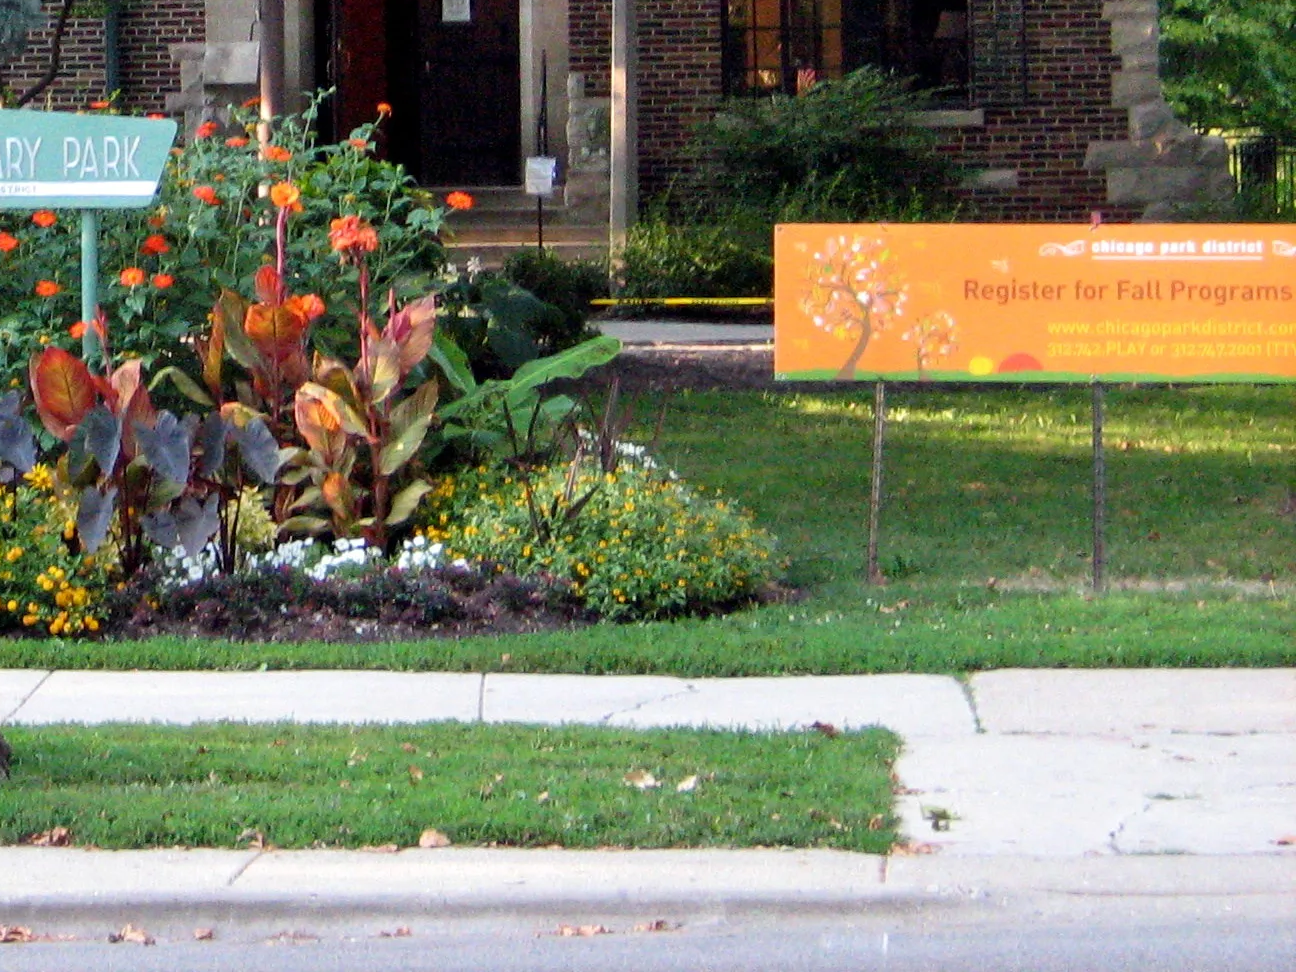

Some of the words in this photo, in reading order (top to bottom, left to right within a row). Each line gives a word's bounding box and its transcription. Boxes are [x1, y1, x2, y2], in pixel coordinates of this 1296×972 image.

[63, 135, 141, 179] PARK
[1091, 239, 1154, 256] chicago
[1160, 239, 1196, 256] park
[1202, 239, 1264, 254] district
[964, 278, 1068, 306] Register
[1075, 280, 1109, 301] for
[1117, 280, 1162, 301] Fall
[1170, 280, 1294, 306] Programs
[1150, 344, 1167, 357] or
